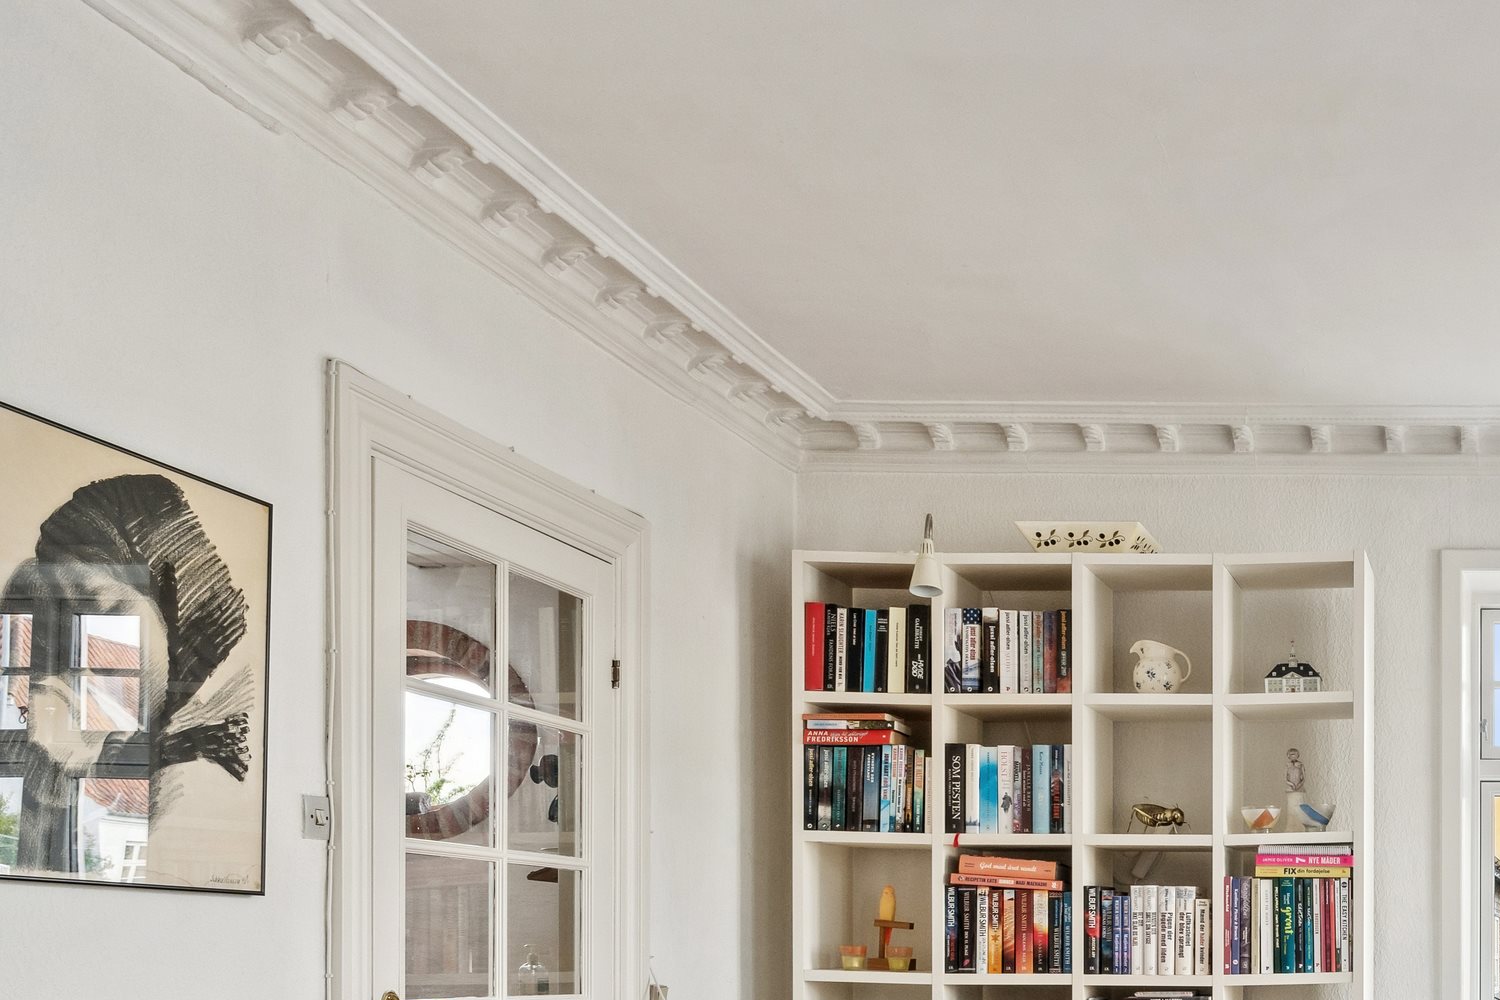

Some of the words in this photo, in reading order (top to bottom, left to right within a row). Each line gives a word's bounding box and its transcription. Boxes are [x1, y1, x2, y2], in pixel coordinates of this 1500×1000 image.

[952, 755, 961, 778] SOM
[952, 781, 961, 820] PESTEN
[1321, 856, 1340, 864] MÅDER
